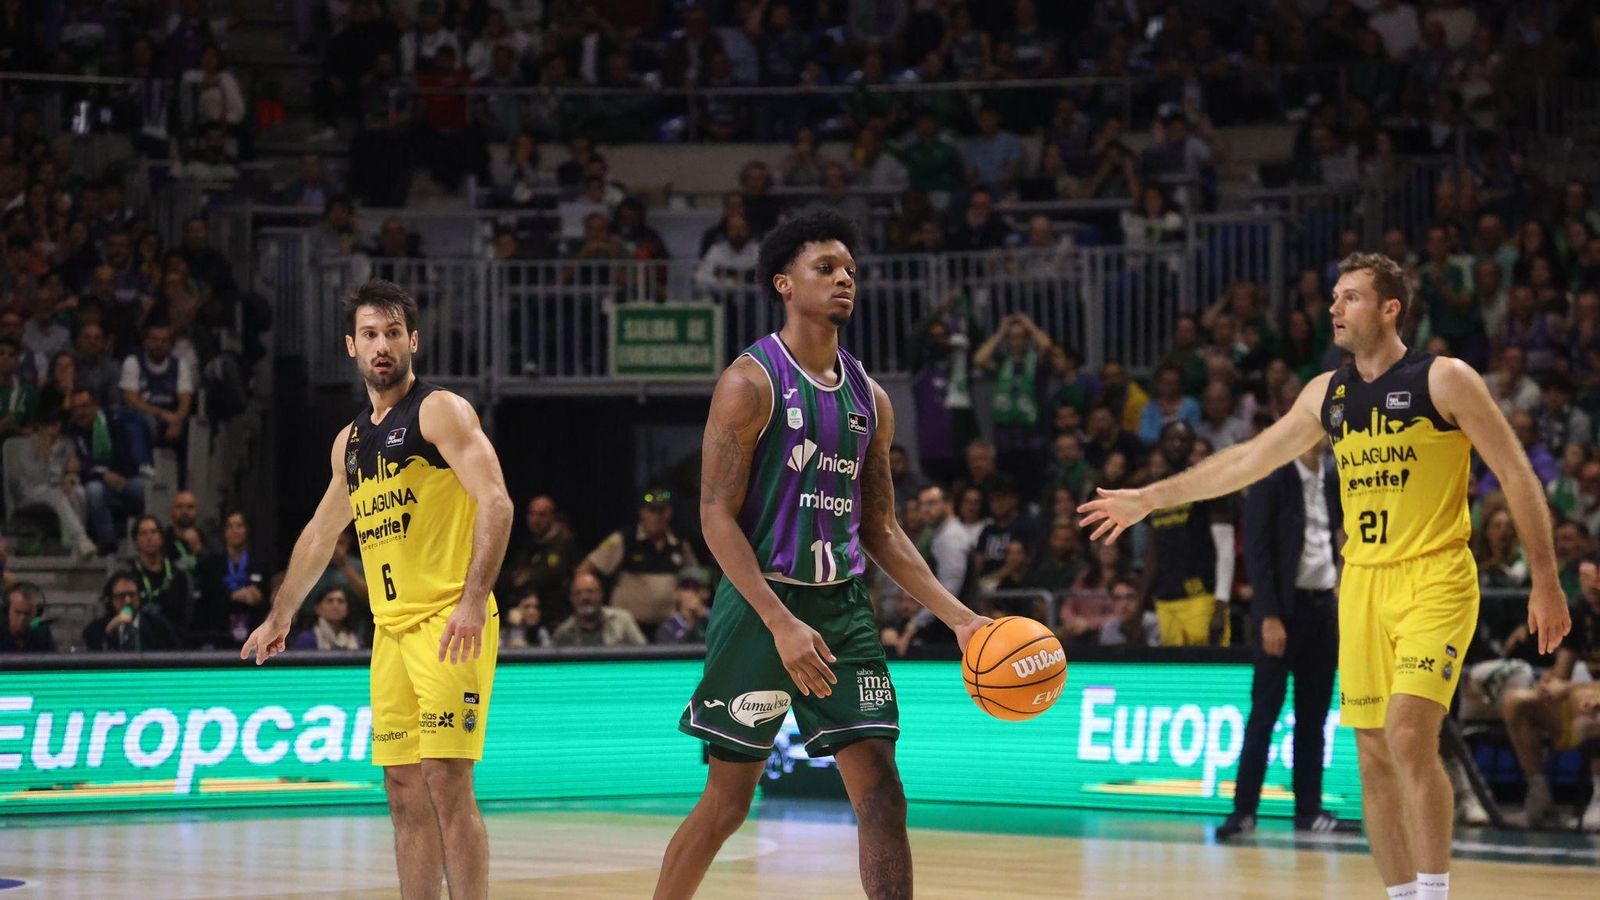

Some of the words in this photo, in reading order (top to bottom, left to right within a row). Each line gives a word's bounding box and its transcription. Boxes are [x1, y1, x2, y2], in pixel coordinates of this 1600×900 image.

[1350, 445, 1418, 467] LAGUNA
[362, 487, 418, 517] LAGUNA
[1359, 510, 1388, 544] 21
[810, 539, 837, 583] 11
[381, 562, 397, 602] 6
[1011, 648, 1065, 678] Wilson
